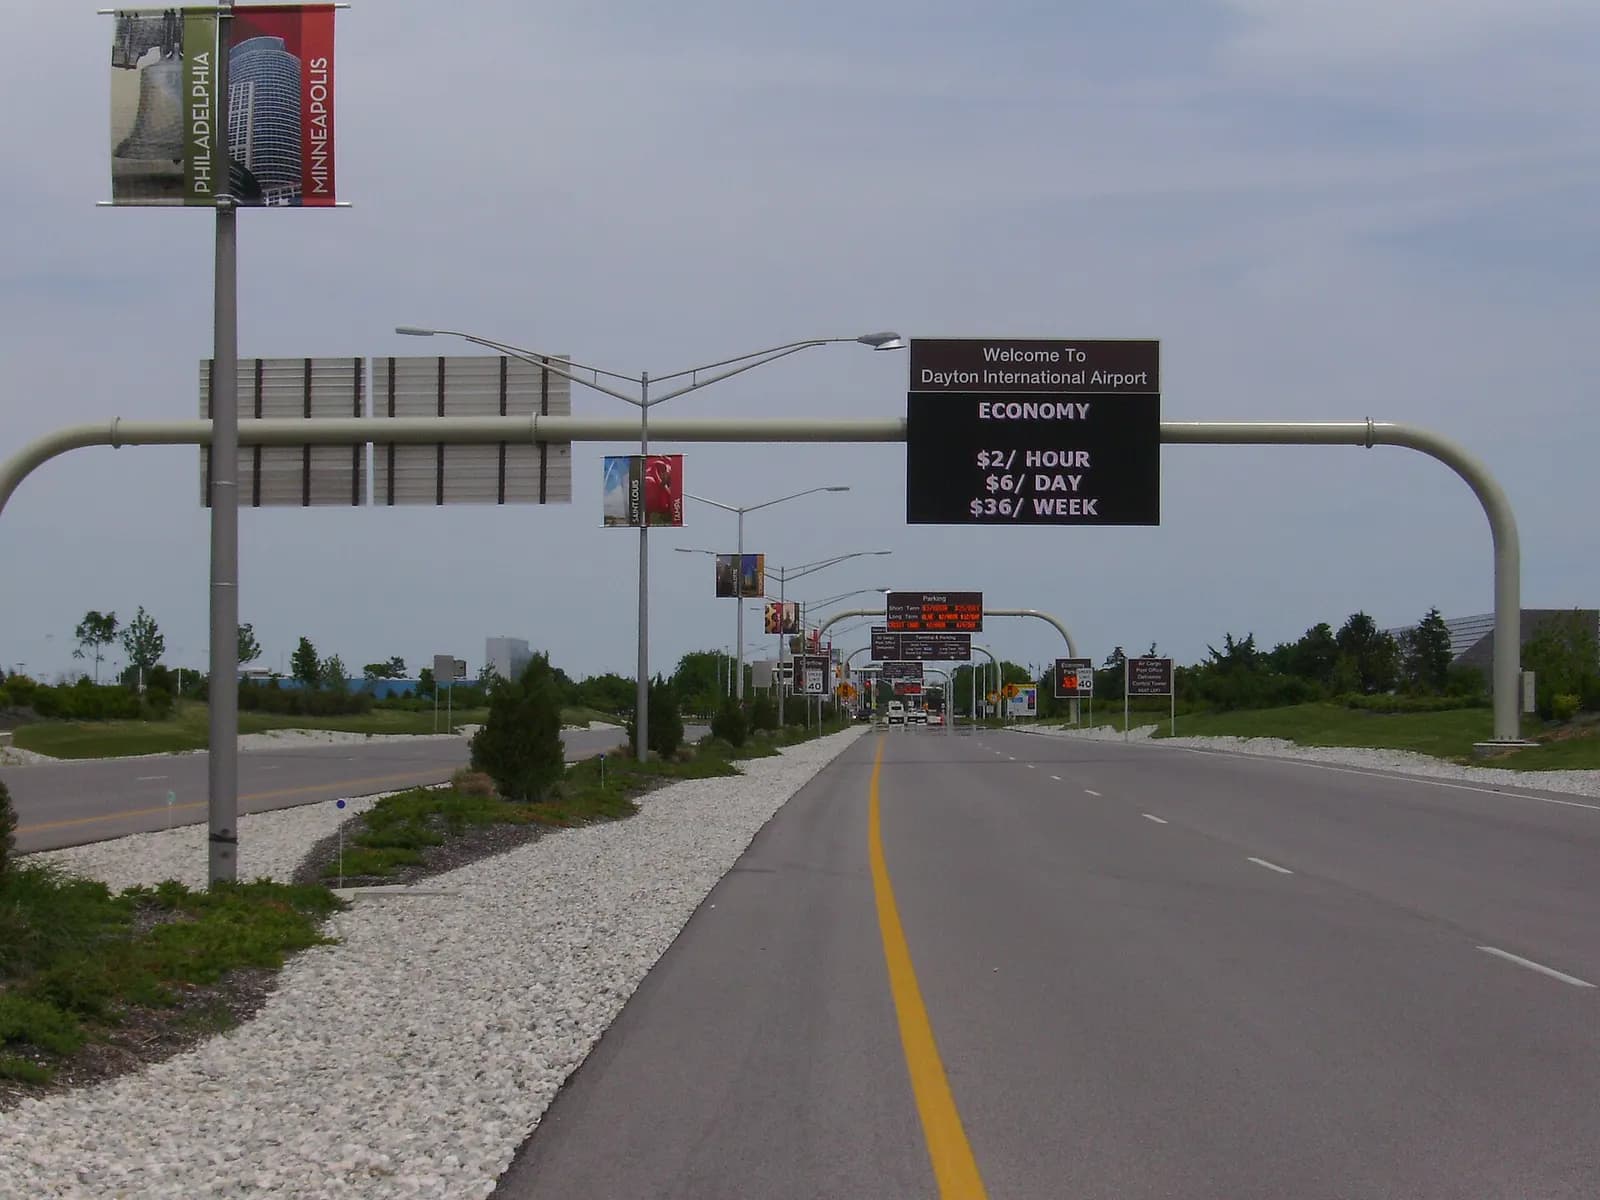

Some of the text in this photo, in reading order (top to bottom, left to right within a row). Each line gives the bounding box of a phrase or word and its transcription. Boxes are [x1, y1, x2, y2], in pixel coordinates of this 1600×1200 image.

[191, 52, 210, 193] PHILADELPHIA
[310, 57, 328, 193] MINNEAPOLIS
[984, 348, 1087, 363] Welcome To
[921, 369, 1148, 388] Dayton International Airport
[979, 402, 1091, 420] ECONOMY
[976, 449, 1091, 470] $2/ HOUR
[985, 473, 1082, 494] $6/ DAY
[631, 479, 640, 523] SAINT LOUIS
[673, 498, 681, 521] TAMPA
[969, 497, 1099, 518] $36/ WEEK
[807, 682, 821, 690] 40
[1078, 680, 1092, 688] 40
